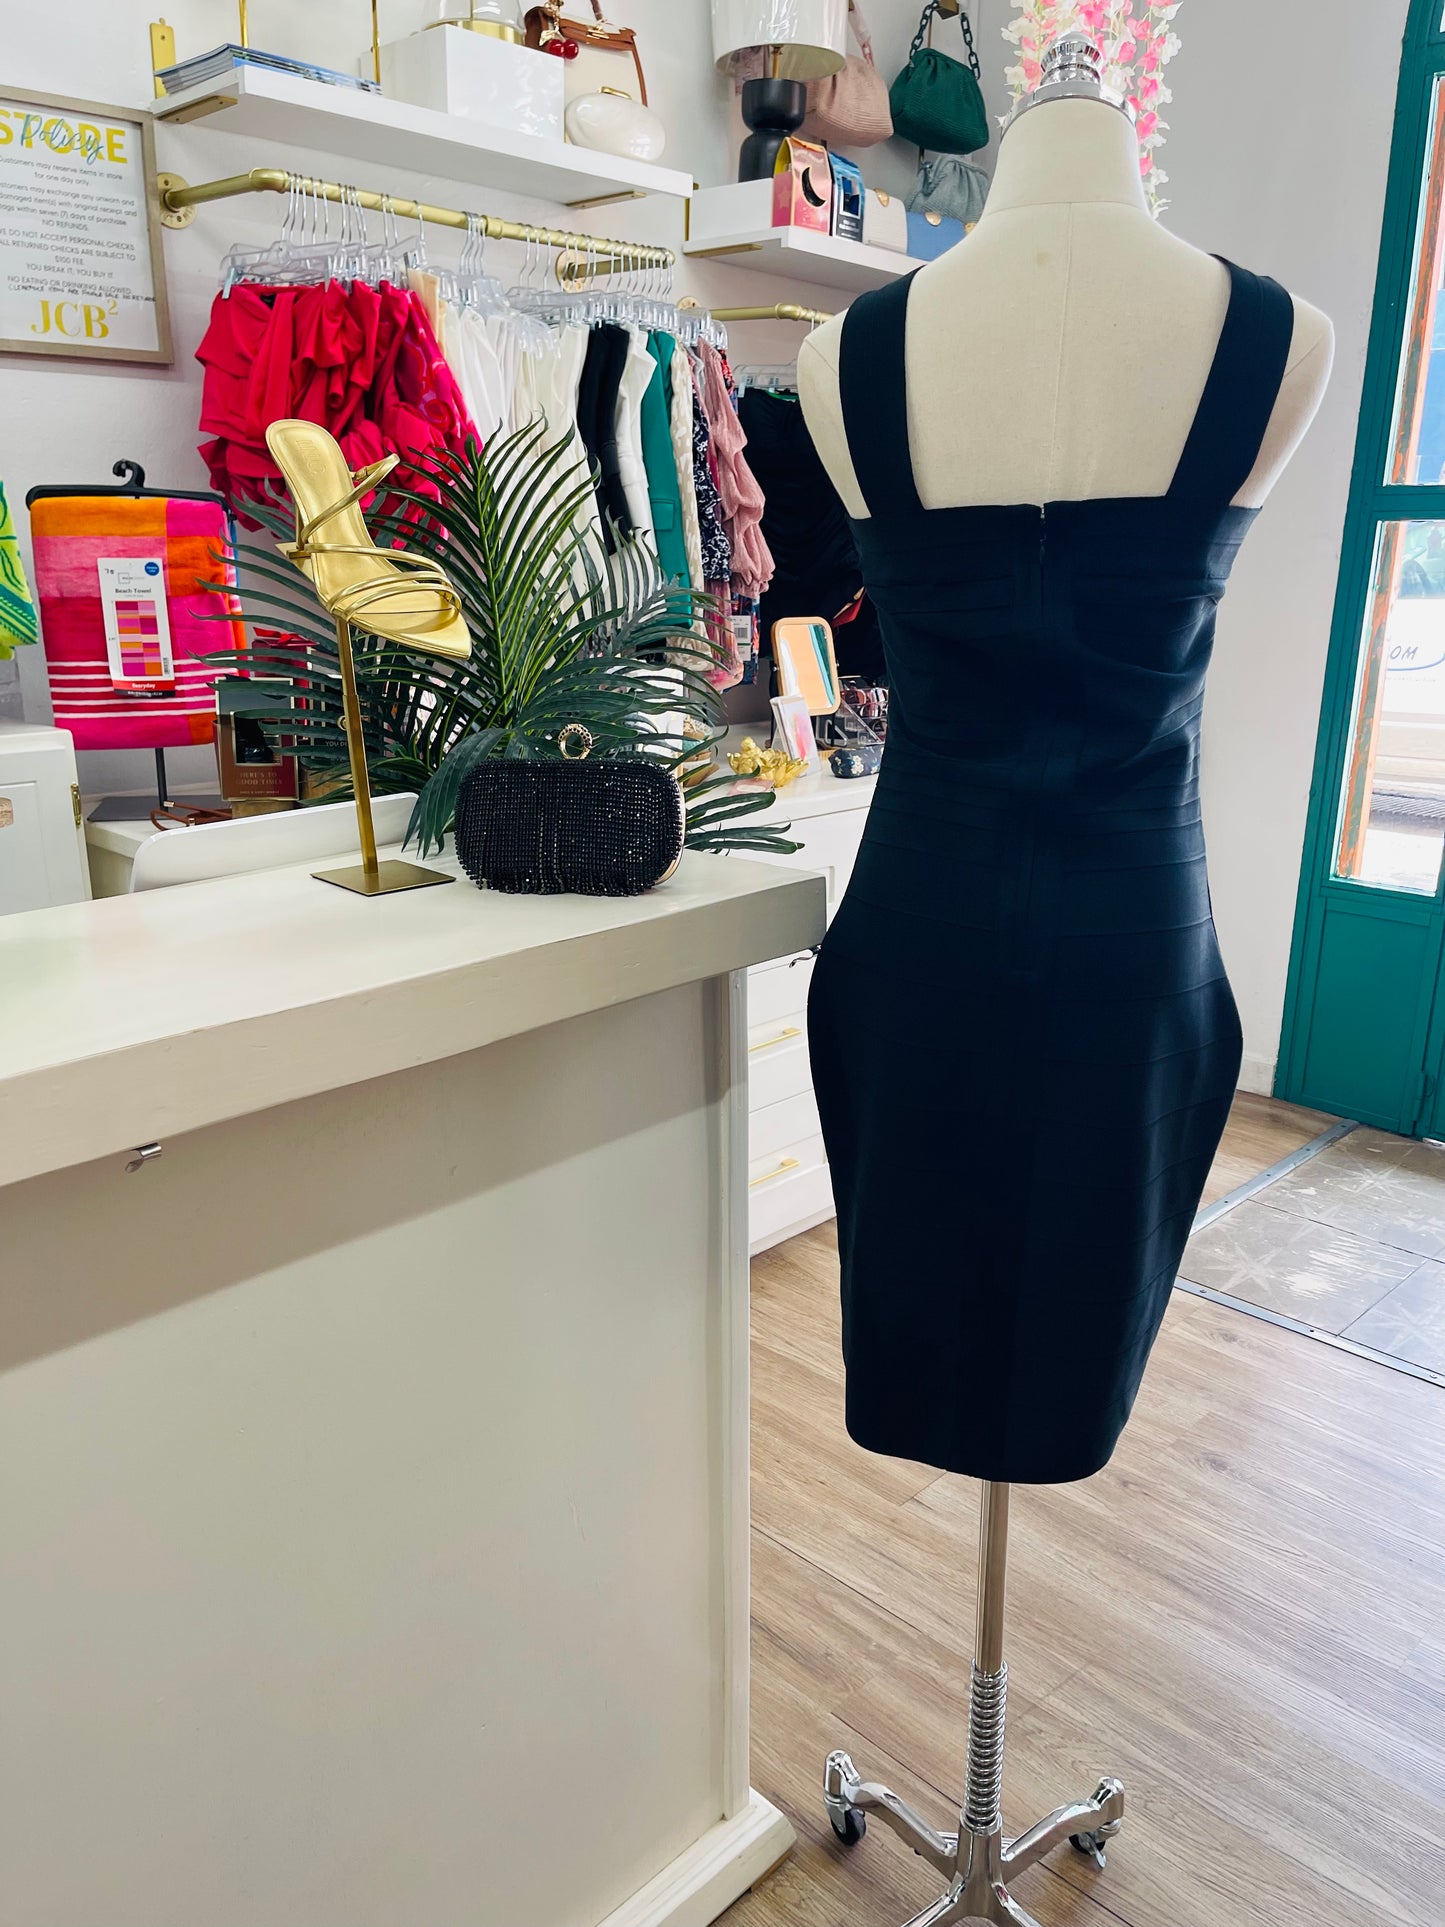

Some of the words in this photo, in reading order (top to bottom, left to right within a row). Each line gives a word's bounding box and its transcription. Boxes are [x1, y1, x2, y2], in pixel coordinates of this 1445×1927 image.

[0, 108, 128, 164] STORE
[21, 113, 105, 165] Policy
[35, 171, 44, 179] for
[61, 175, 73, 184] day
[53, 164, 77, 173] reserve
[80, 168, 97, 177] items
[106, 172, 123, 180] store
[47, 188, 79, 199] exchange
[16, 205, 37, 214] within
[70, 213, 86, 222] days
[59, 200, 72, 208] with
[74, 203, 98, 211] original
[100, 206, 122, 215] receipt
[123, 209, 137, 217] and
[42, 219, 55, 227] NO
[9, 228, 20, 237] DO
[22, 230, 38, 239] NOT
[40, 233, 68, 242] ACCEPT
[69, 236, 105, 248] PERSONAL
[12, 240, 49, 251] RETURNED
[51, 244, 79, 254] CHECKS
[81, 248, 94, 256] ARE
[96, 250, 124, 260] SUBJECT
[126, 253, 136, 261] TO
[26, 263, 42, 271] YOU
[43, 265, 65, 273] BREAK
[77, 269, 91, 277] YOU
[93, 270, 105, 278] BUY
[8, 275, 20, 283] NO
[22, 276, 48, 286] EATING
[62, 280, 97, 291] DRINKING
[131, 682, 156, 690] Everyday
